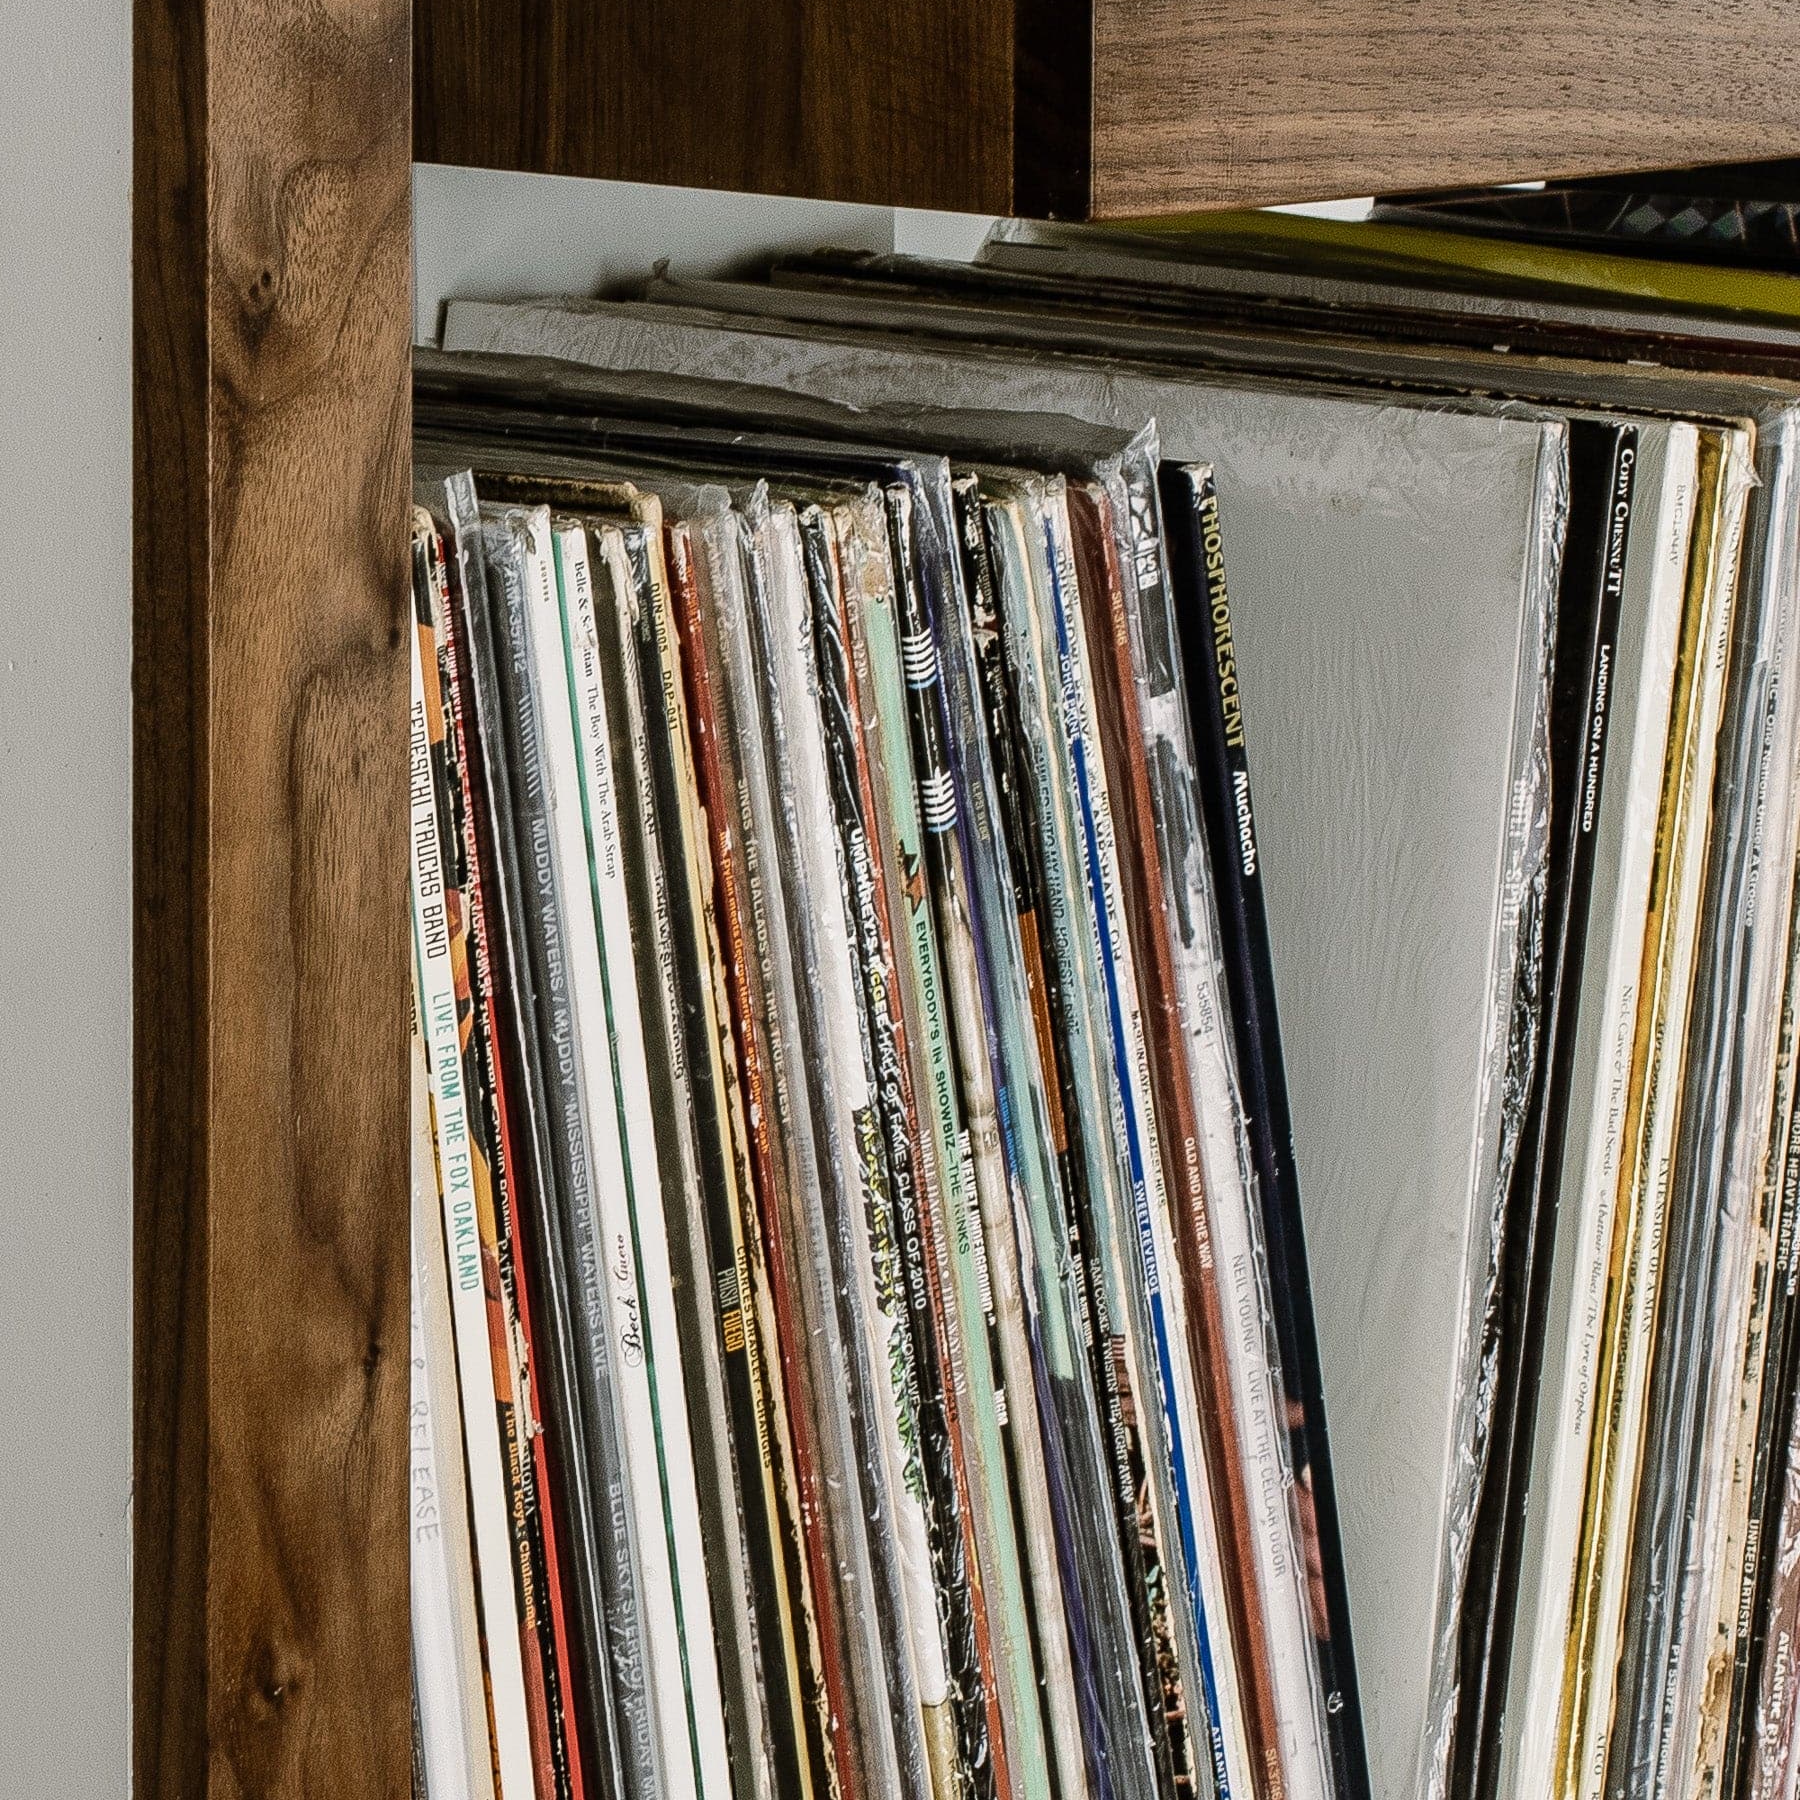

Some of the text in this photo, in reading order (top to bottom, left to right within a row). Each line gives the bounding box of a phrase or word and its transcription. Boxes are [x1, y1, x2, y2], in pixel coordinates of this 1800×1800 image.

[1198, 495, 1245, 749] PHOSPHORESCENT
[661, 669, 679, 731] DAP-041
[1057, 651, 1075, 693] JOHN
[572, 560, 617, 880] Belle & The Boy With The Arab Strap
[1581, 644, 1612, 833] LANDING ON A HUNDRED
[1231, 769, 1259, 875] Muchacho
[720, 857, 736, 896] Dylan
[1743, 869, 1760, 928] Groove
[421, 904, 448, 960] BAND
[727, 896, 742, 937] meets
[430, 991, 454, 1033] LIVE
[738, 986, 754, 1042] Harrison
[748, 876, 794, 1125] BALLADS OF THE TRUE WEST
[912, 920, 945, 1064] EVERYBODY'S IN
[1195, 981, 1216, 1048] 535854-1
[1618, 984, 1634, 1018] Nick
[1614, 1021, 1628, 1057] Cave
[435, 1044, 461, 1100] FROM
[530, 817, 608, 1380] MUDDY WATERS MUDDY WATERS LIVE
[1609, 1076, 1623, 1103] The
[442, 1108, 466, 1146] THE
[756, 1121, 770, 1154] Cash
[1606, 1107, 1620, 1135] Bad
[446, 1154, 470, 1193] FOX
[1600, 1136, 1616, 1177] Seeds
[1781, 1156, 1799, 1207] HEAVY
[895, 1174, 917, 1233] CLASS
[954, 1129, 994, 1311] THE VELVET UNDERGROUND
[1182, 1136, 1213, 1270] OLD AND IN THE WAY
[450, 1201, 480, 1291] OAKLAND
[904, 1237, 921, 1262] OF
[917, 1127, 970, 1395] MERLE HAGGARD THE WAY AM
[1131, 1179, 1162, 1294] SWEET REVENGE
[1775, 1208, 1793, 1271] TRAFFIC
[606, 1231, 645, 1369] Beck Guero
[908, 1264, 928, 1310] 2010
[1088, 1257, 1103, 1287] SAM
[714, 1267, 747, 1353] PHISH FUEGO
[1093, 1286, 1111, 1332] COOKE
[735, 1245, 774, 1469] CHARLES BRADLEY CHANGES
[1578, 1332, 1594, 1362] Lyre
[904, 1370, 922, 1406] LIVE
[992, 1389, 1009, 1426] MGM
[1108, 1394, 1123, 1422] THE
[1229, 1254, 1286, 1578] NEIL YOUNG LIVE AT THE CELLAR DOOR
[1569, 1381, 1588, 1436] Orpheus
[1112, 1421, 1129, 1461] NIGHT
[1117, 1462, 1136, 1504] AWAY
[504, 1409, 539, 1628] The Black Keys Chulahoma
[606, 1482, 628, 1542] BLUE
[614, 1547, 634, 1591] SKY
[1734, 1517, 1761, 1638] UNITED ARTISTS
[1768, 1630, 1791, 1720] ATLANTIC
[631, 1695, 655, 1769] FRIDAY
[1654, 1725, 1672, 1783] Priority
